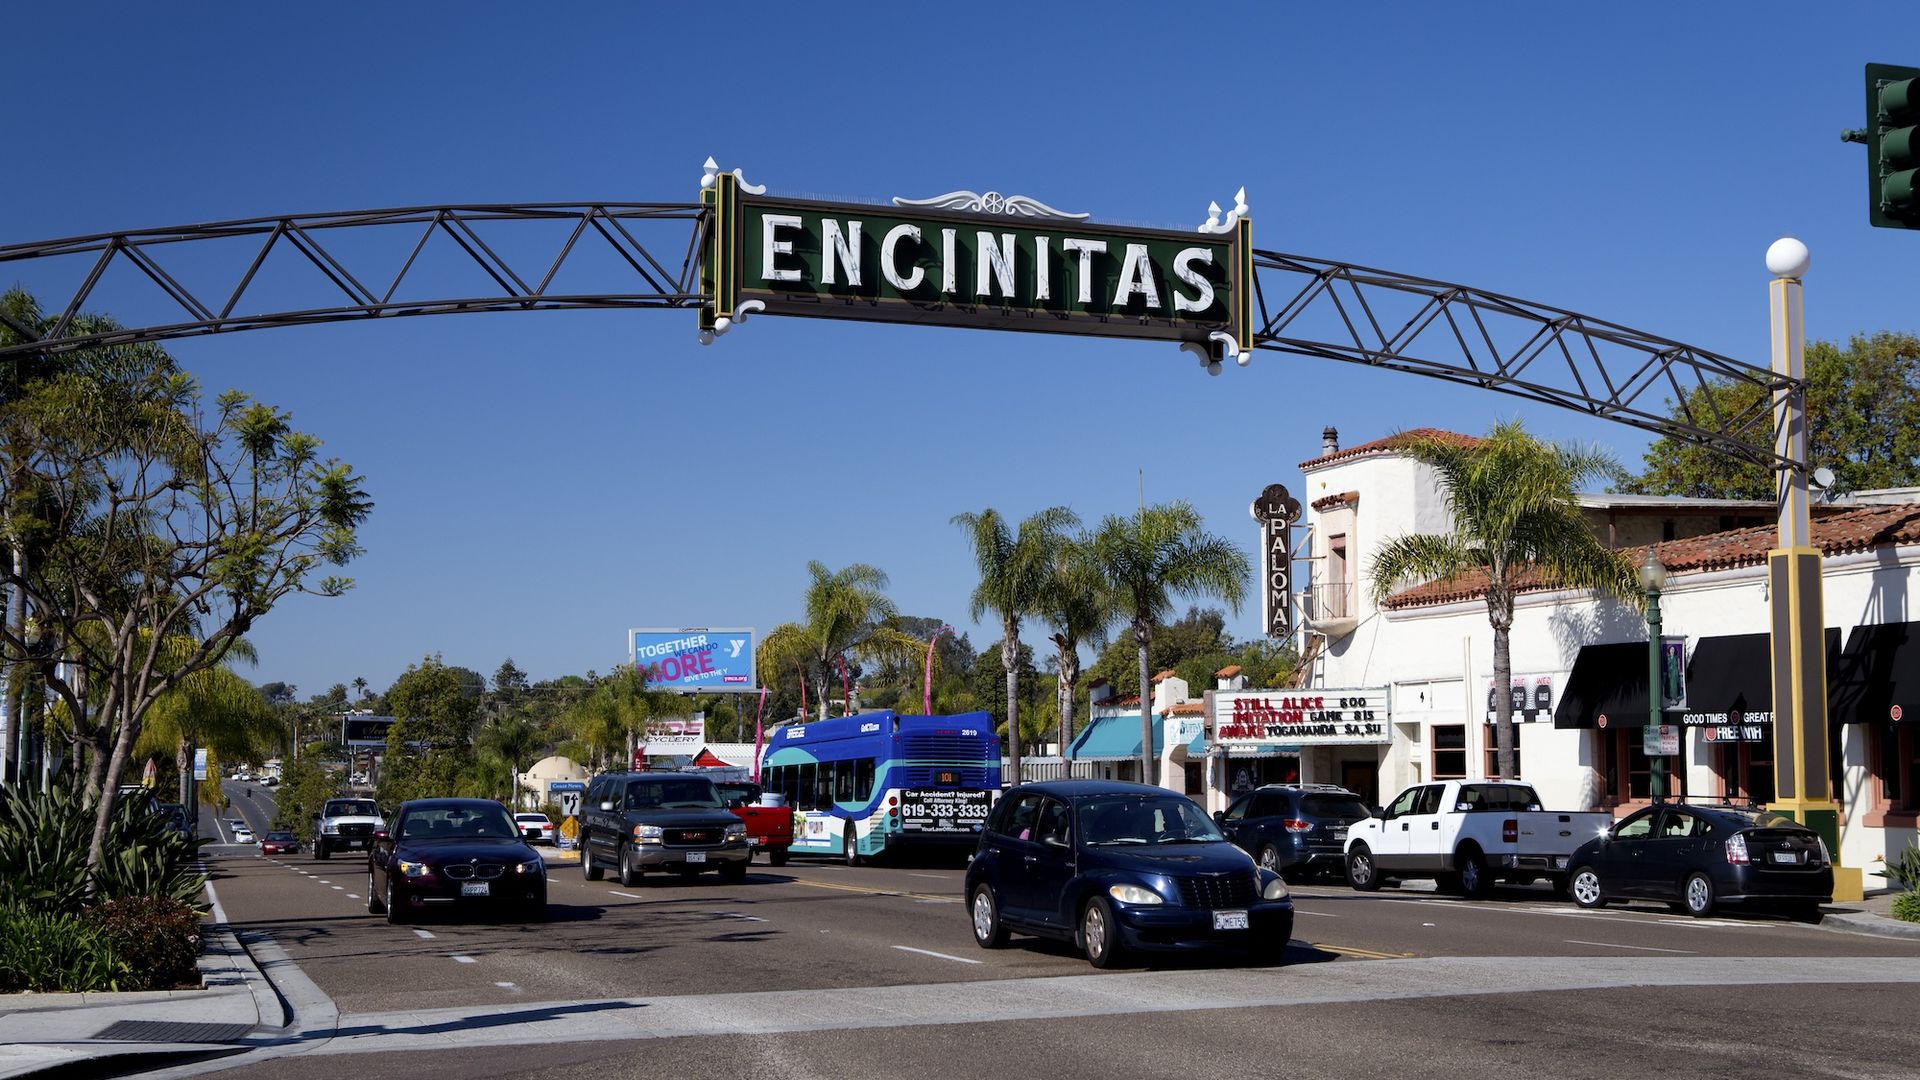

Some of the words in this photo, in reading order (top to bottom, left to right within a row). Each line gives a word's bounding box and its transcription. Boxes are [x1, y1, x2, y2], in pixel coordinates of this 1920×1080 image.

[761, 213, 1215, 313] ENCINITAS
[1268, 503, 1287, 514] LA
[1270, 518, 1288, 625] PALOMA
[637, 634, 708, 659] TOGETHER
[673, 649, 685, 658] WE
[687, 646, 705, 656] CAN
[706, 642, 718, 651] DO
[636, 650, 715, 683] MORE
[684, 674, 699, 682] GIVE
[700, 672, 710, 680] TO
[1536, 676, 1551, 685] WED
[1234, 697, 1274, 710] STILL
[1282, 696, 1324, 710] ALICE
[1340, 697, 1367, 709] 600
[1233, 710, 1304, 724] IMITATION
[1310, 711, 1343, 722] GAME
[1354, 710, 1375, 722] 815
[1683, 713, 1705, 724] GOOD
[1705, 713, 1728, 724] TIMES
[1743, 712, 1769, 723] GREAT
[1218, 725, 1265, 739] AWAKE
[1266, 724, 1337, 737] YOGANANDA
[1716, 726, 1739, 740] FREE
[942, 772, 952, 782] 101
[956, 791, 986, 799] Injured?
[902, 803, 989, 817] 619-333-3333
